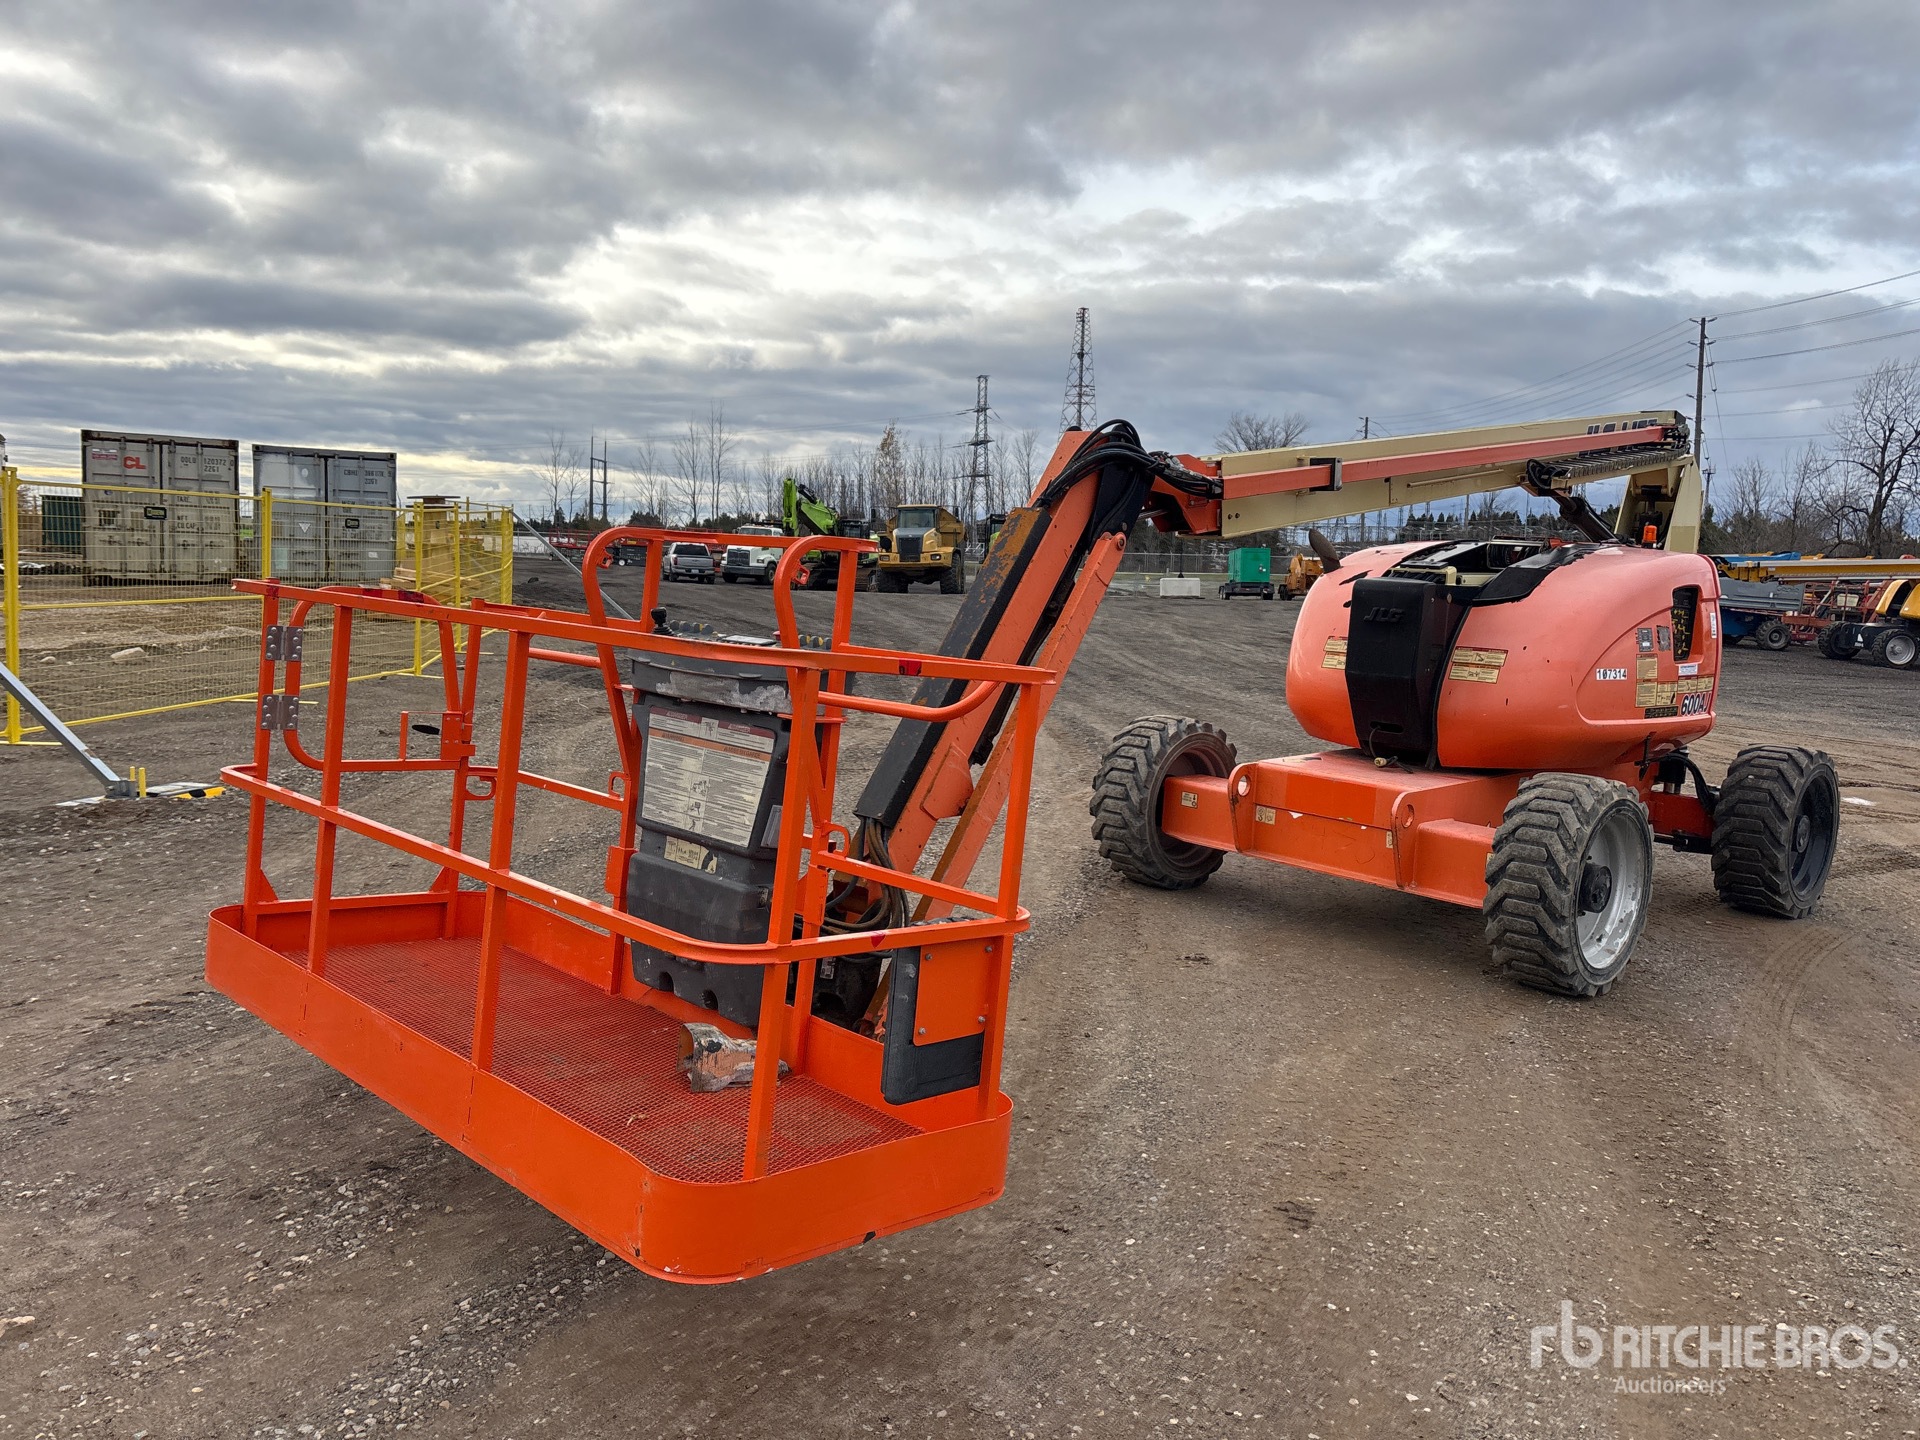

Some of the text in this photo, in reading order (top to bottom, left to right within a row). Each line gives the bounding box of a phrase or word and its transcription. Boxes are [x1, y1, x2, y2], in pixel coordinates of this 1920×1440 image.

[1363, 606, 1404, 622] JLG
[1597, 668, 1627, 680] 107314
[1680, 692, 1712, 717] 600AJ
